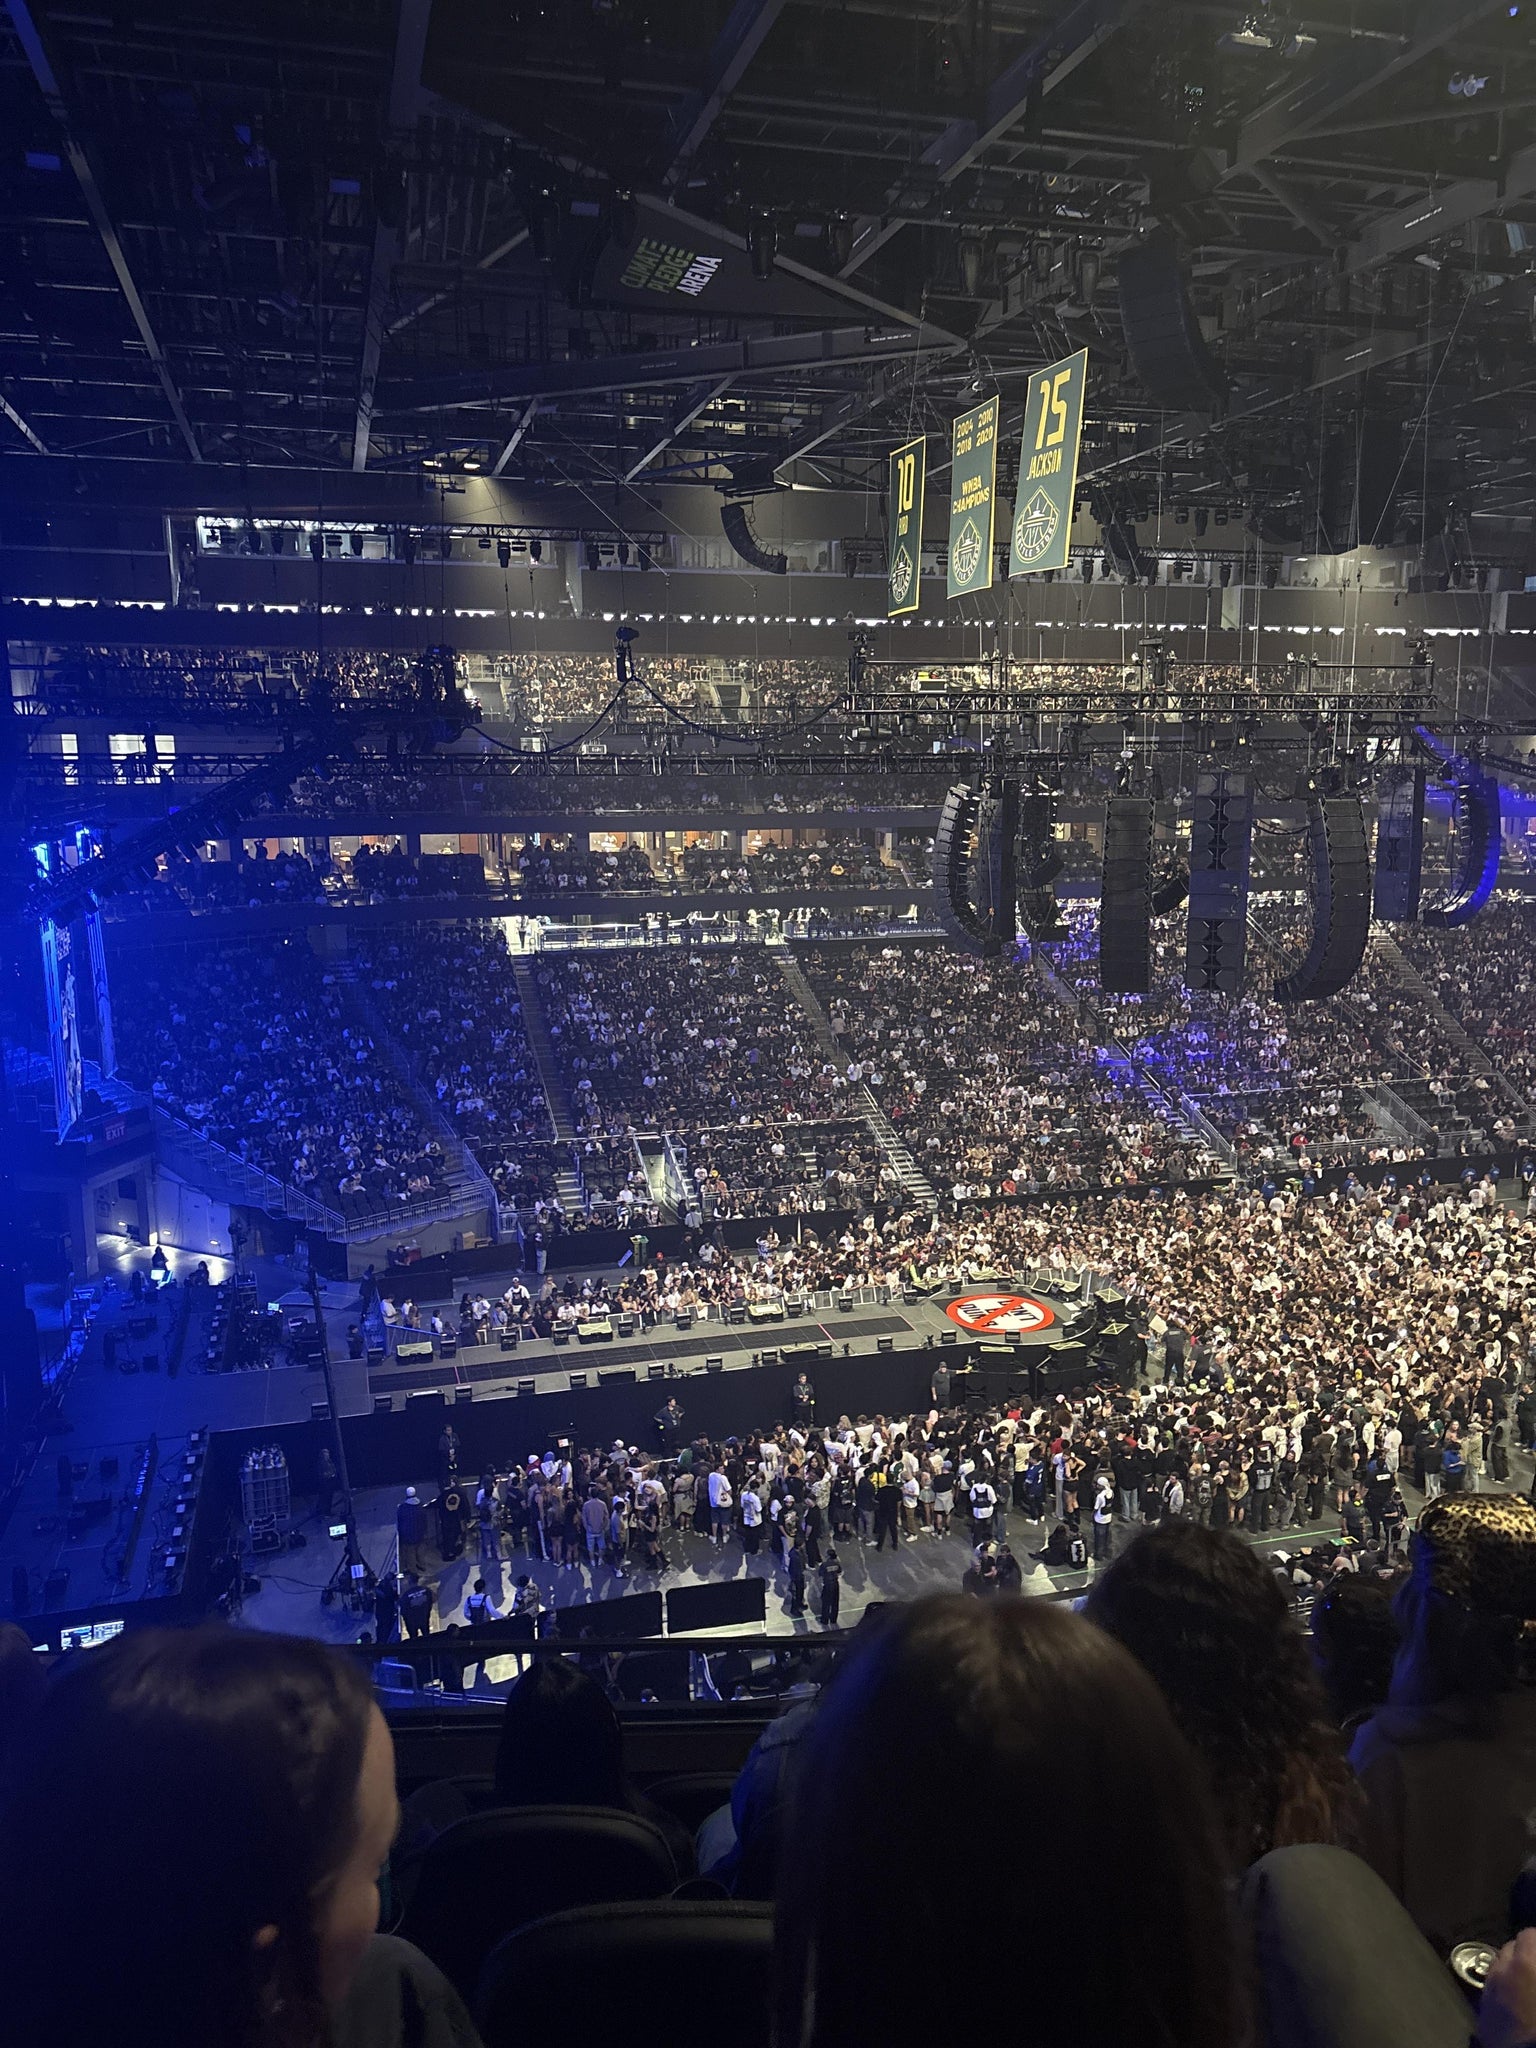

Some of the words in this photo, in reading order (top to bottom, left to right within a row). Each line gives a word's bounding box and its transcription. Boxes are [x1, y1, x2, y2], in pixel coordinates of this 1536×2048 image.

[620, 238, 667, 288] CLIMATE
[647, 247, 694, 293] PLEDGE
[676, 256, 723, 296] ARENA
[957, 419, 974, 438] 2004
[978, 406, 993, 428] 2010
[1035, 368, 1071, 450] 15
[956, 437, 971, 456] 2018
[976, 426, 993, 447] 2020
[1026, 447, 1063, 480] JACKSON
[897, 453, 915, 514] 10
[953, 486, 990, 514] CHAMPIONS
[962, 475, 982, 495] WNBA
[106, 1126, 125, 1141] EXIT
